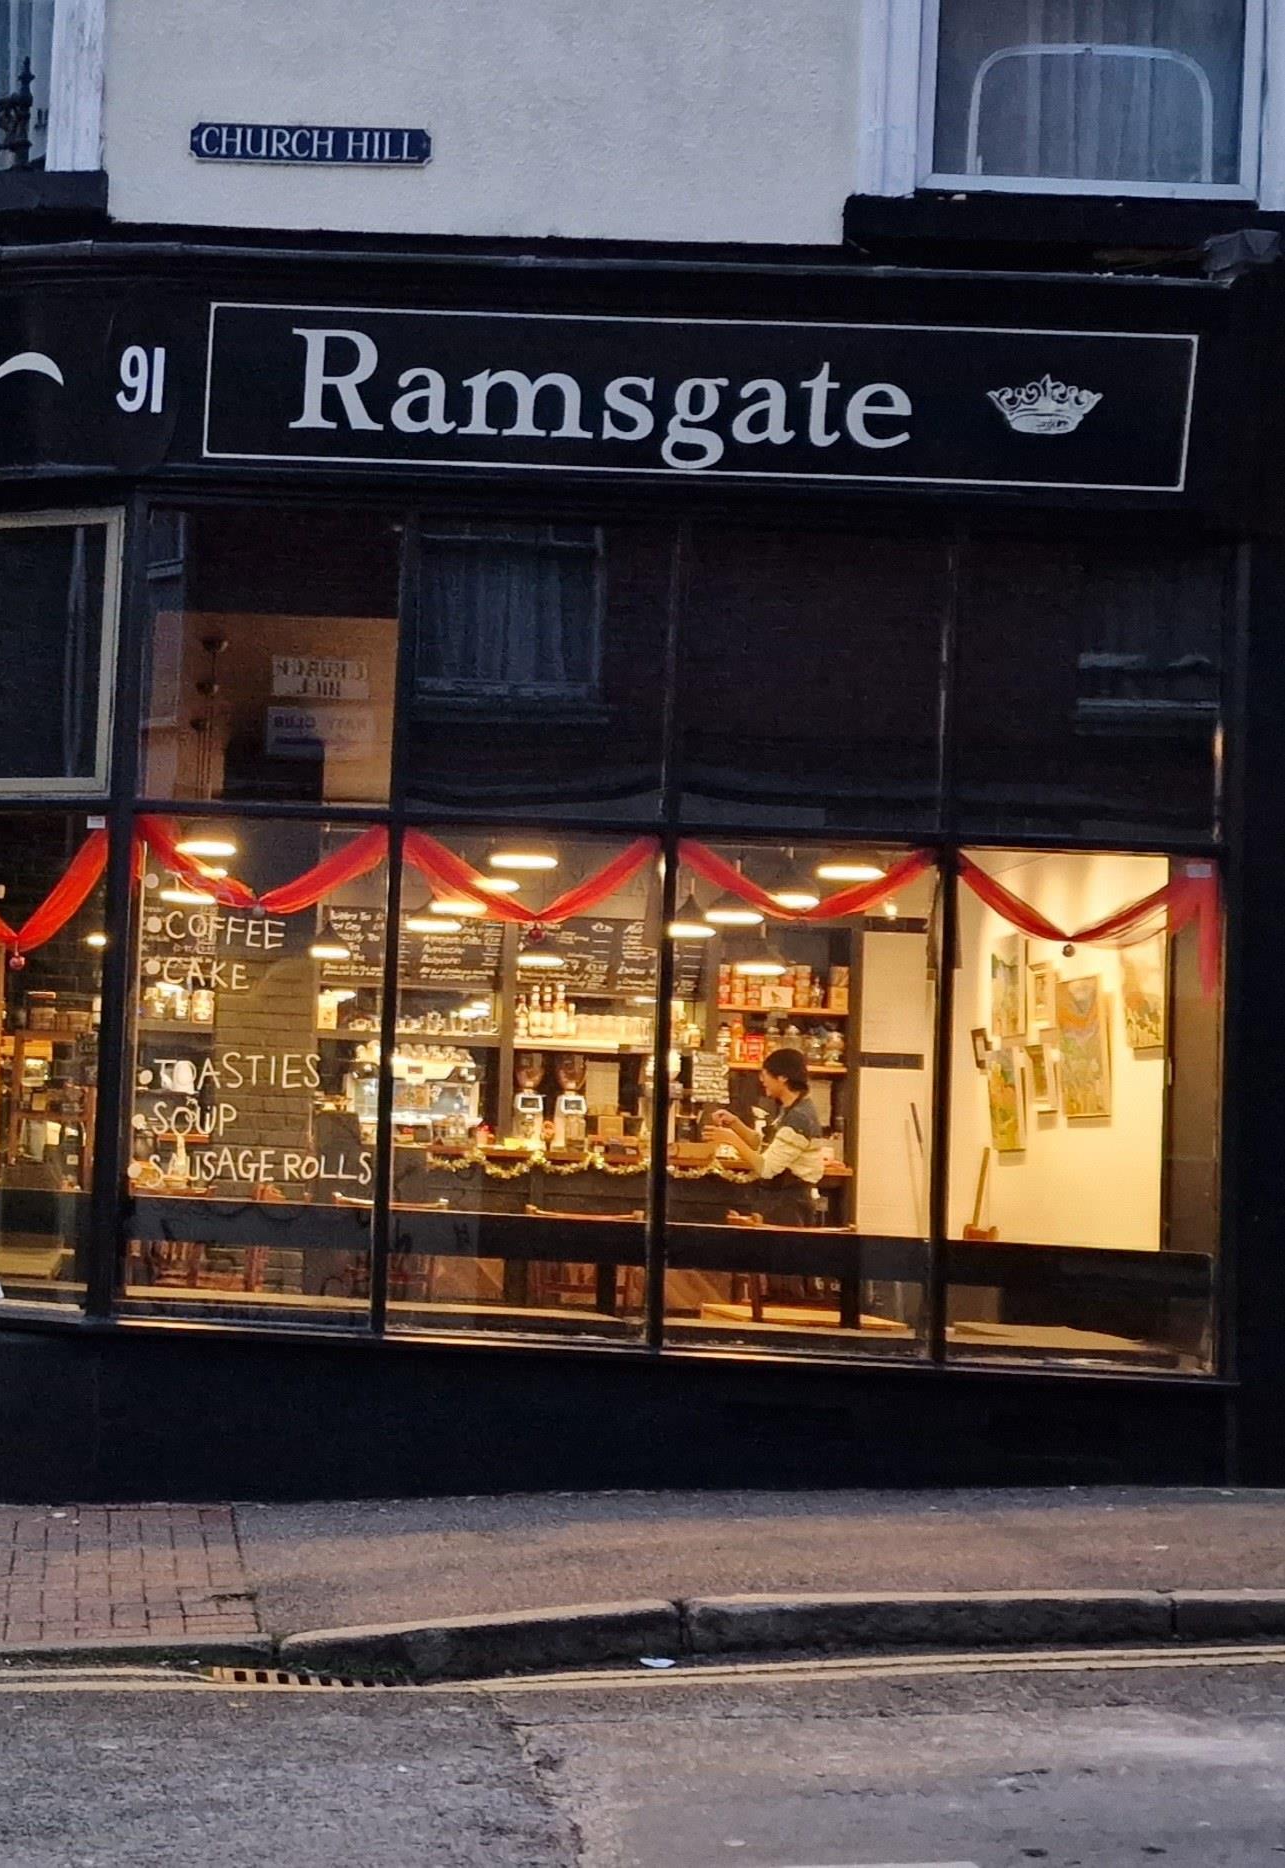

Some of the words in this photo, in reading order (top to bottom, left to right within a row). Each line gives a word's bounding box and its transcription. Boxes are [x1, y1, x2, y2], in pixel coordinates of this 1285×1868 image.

[200, 126, 334, 158] CHURCH
[346, 130, 419, 161] HILL
[116, 345, 166, 414] 91
[288, 326, 913, 471] Ramsgate
[166, 910, 286, 950] COFFEE
[163, 957, 250, 991] CAKE
[154, 1051, 321, 1091] TOASTIES
[151, 1101, 237, 1137] SOUP
[147, 1146, 275, 1188] SAUSAGE
[283, 1152, 373, 1186] ROLLS
